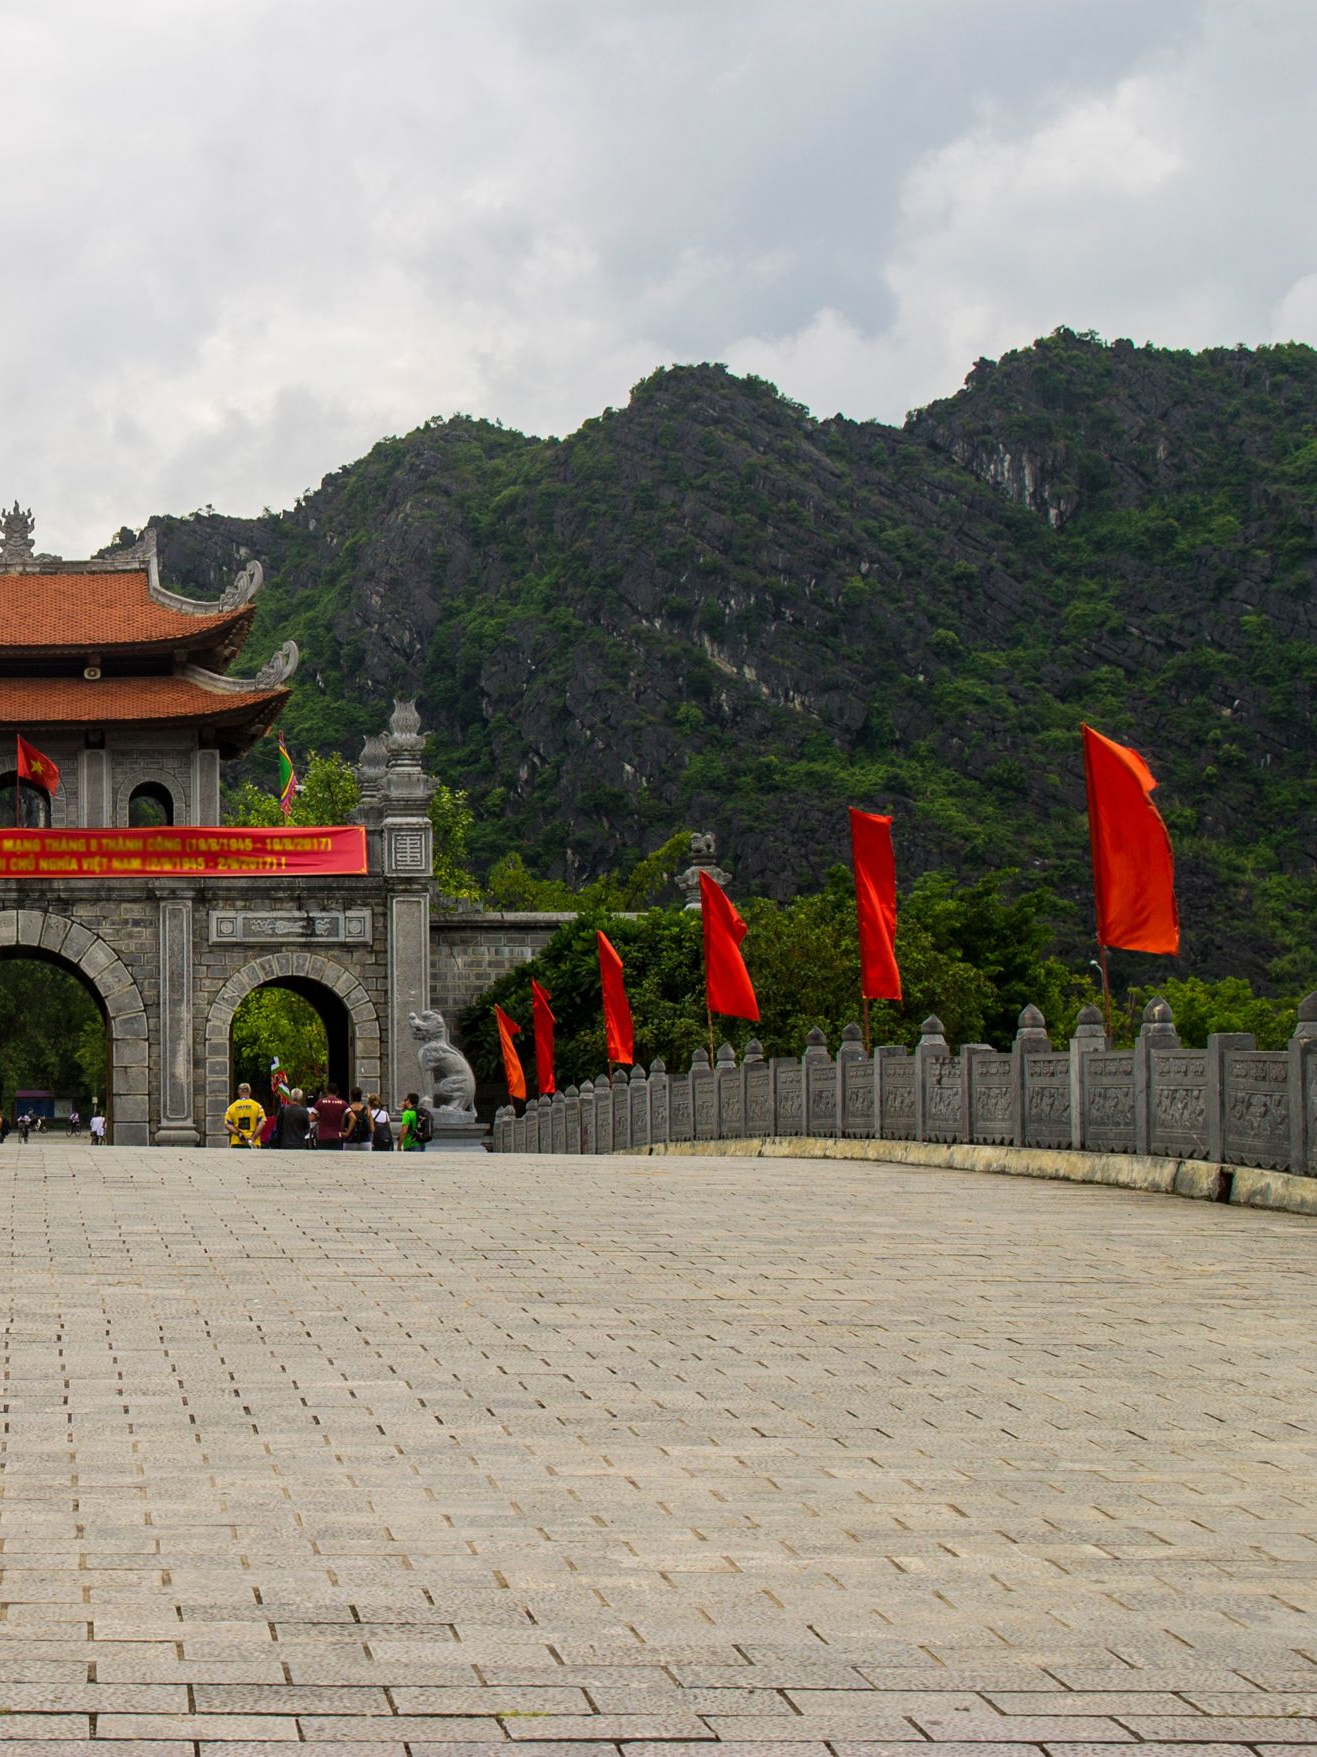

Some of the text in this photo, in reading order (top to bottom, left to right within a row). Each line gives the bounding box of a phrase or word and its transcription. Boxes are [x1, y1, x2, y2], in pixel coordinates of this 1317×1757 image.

[3, 838, 40, 855] MẠNG
[44, 837, 86, 852] THÁNG
[90, 838, 98, 851] 8
[102, 836, 142, 851] THÀNH
[146, 836, 181, 851] CÔNG
[10, 855, 35, 871] CHỦ
[39, 856, 78, 871] NGHĨA
[81, 856, 108, 873] VIỆT
[112, 857, 141, 870] NAM
